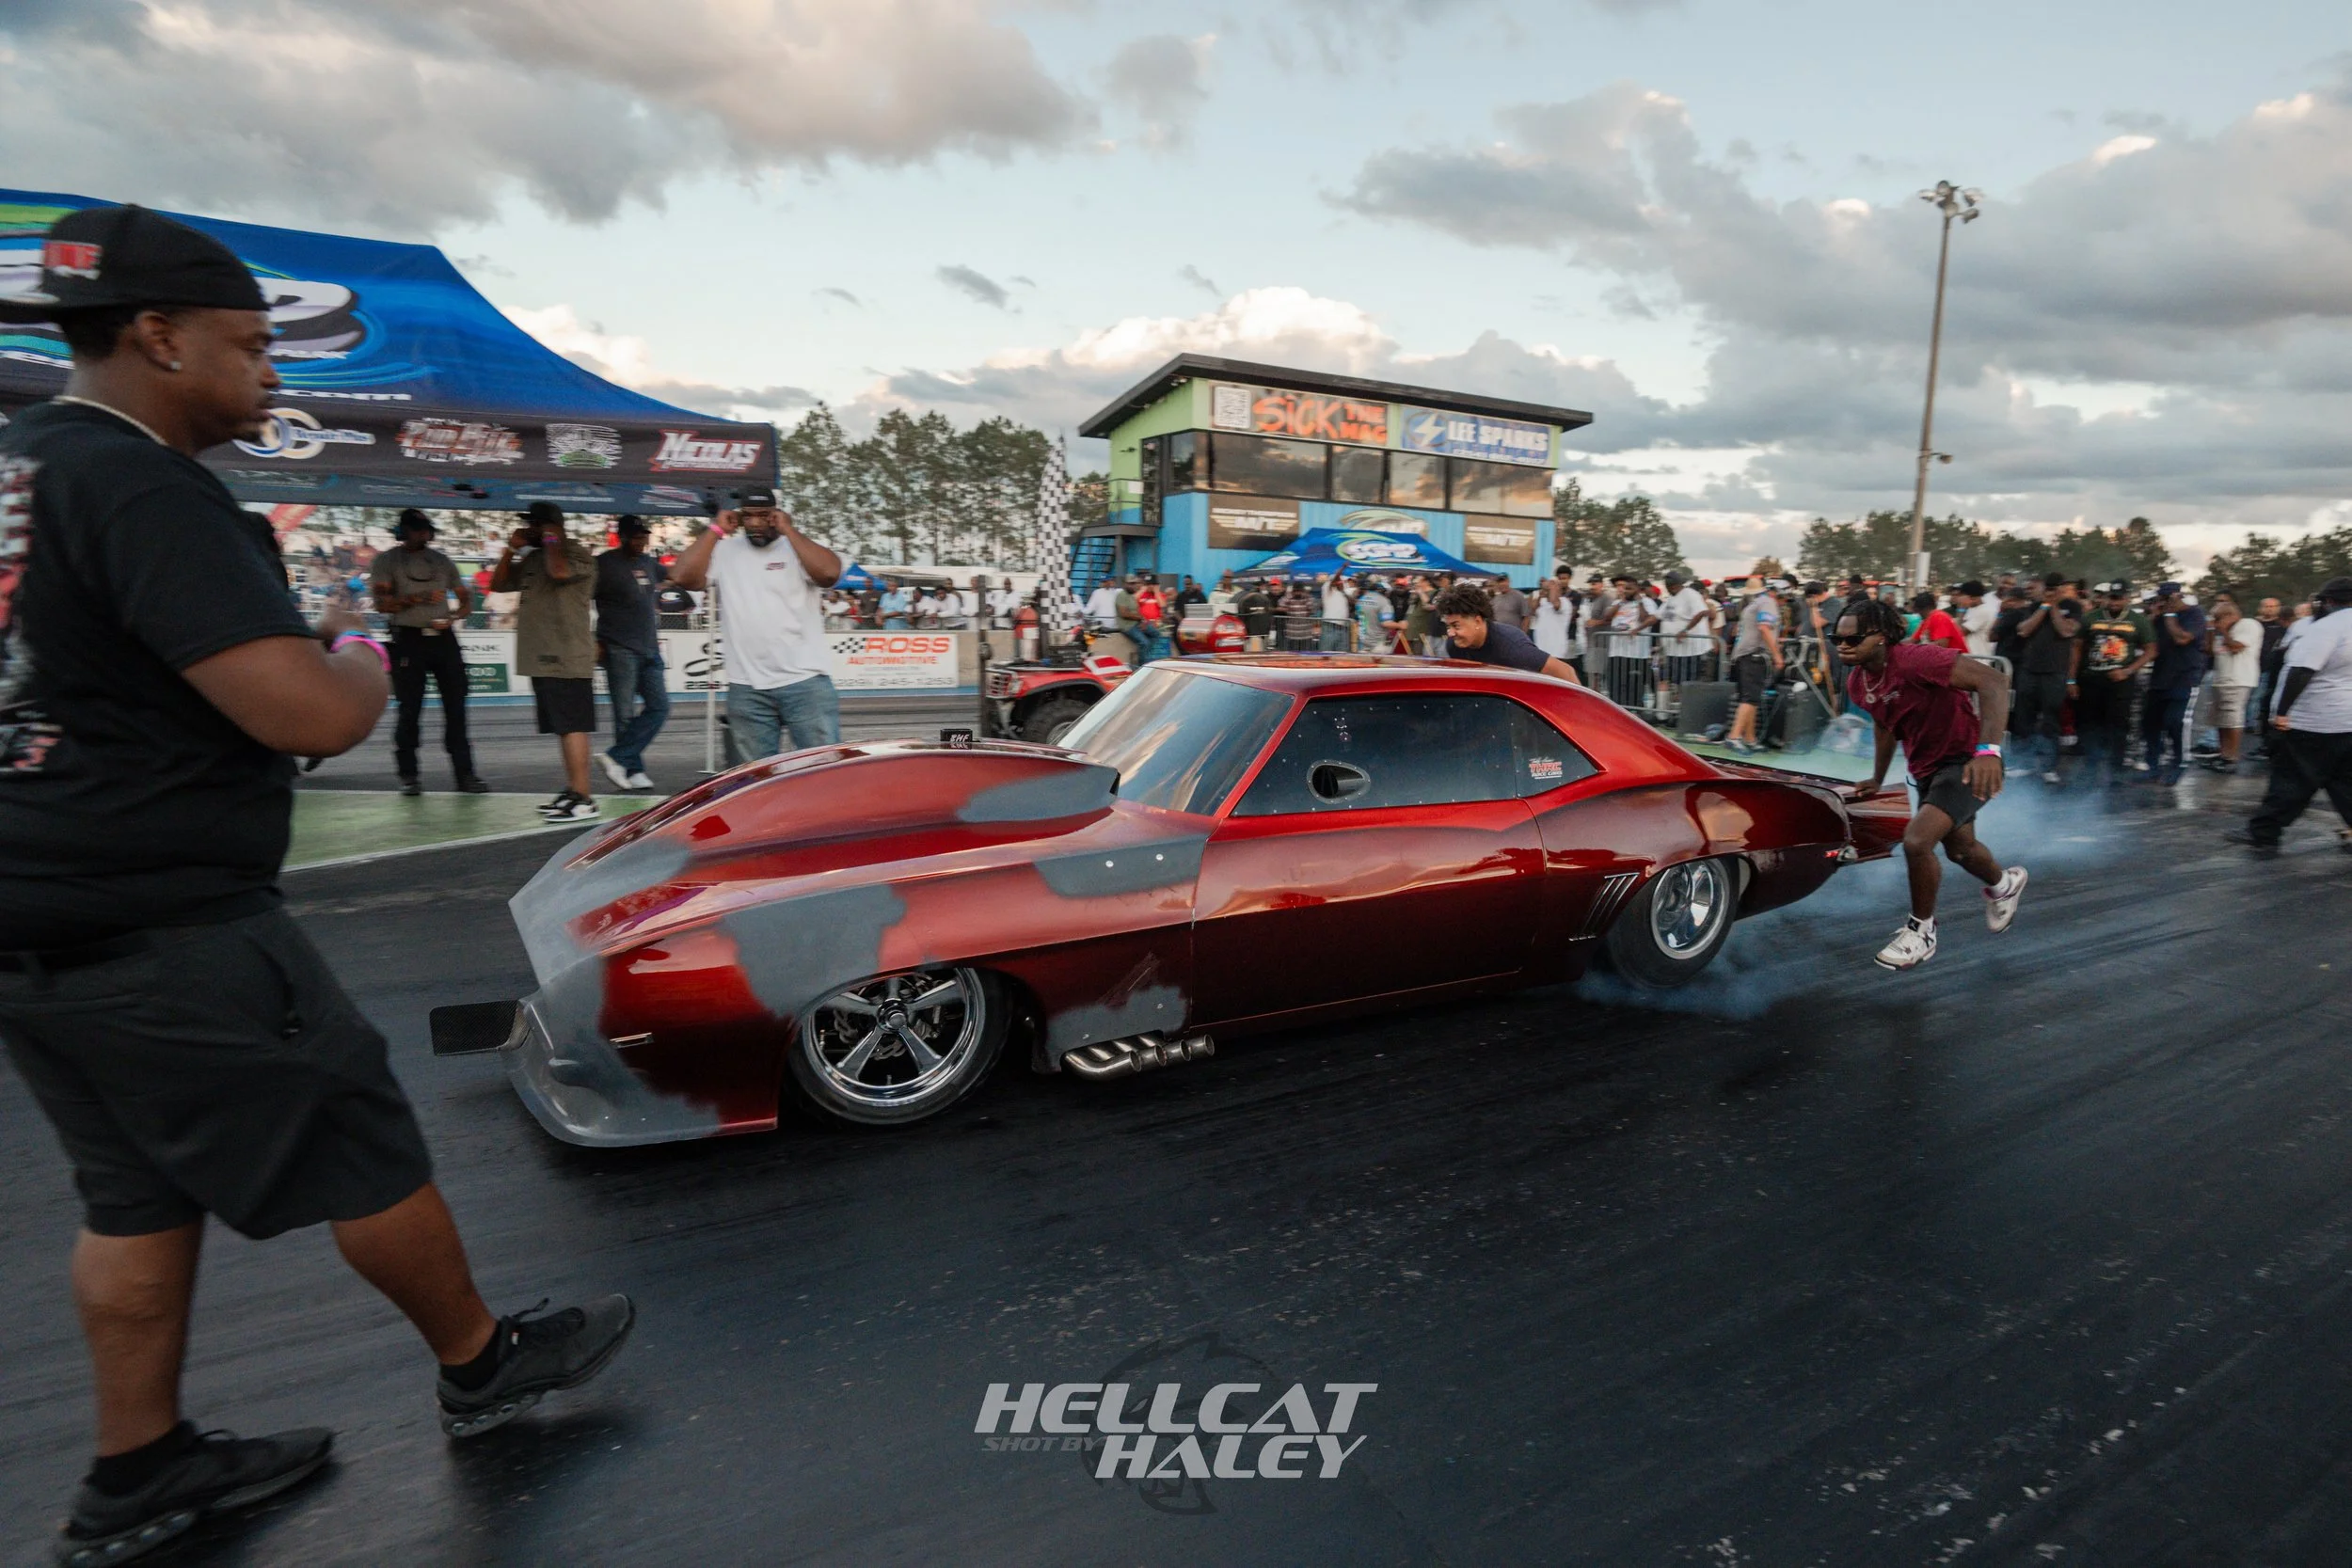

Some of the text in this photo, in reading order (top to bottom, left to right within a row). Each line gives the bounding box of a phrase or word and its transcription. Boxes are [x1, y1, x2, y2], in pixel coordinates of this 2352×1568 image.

[1447, 420, 1477, 443] LEE
[865, 637, 950, 654] ROSS
[846, 656, 939, 665] AUTOMOTIVE
